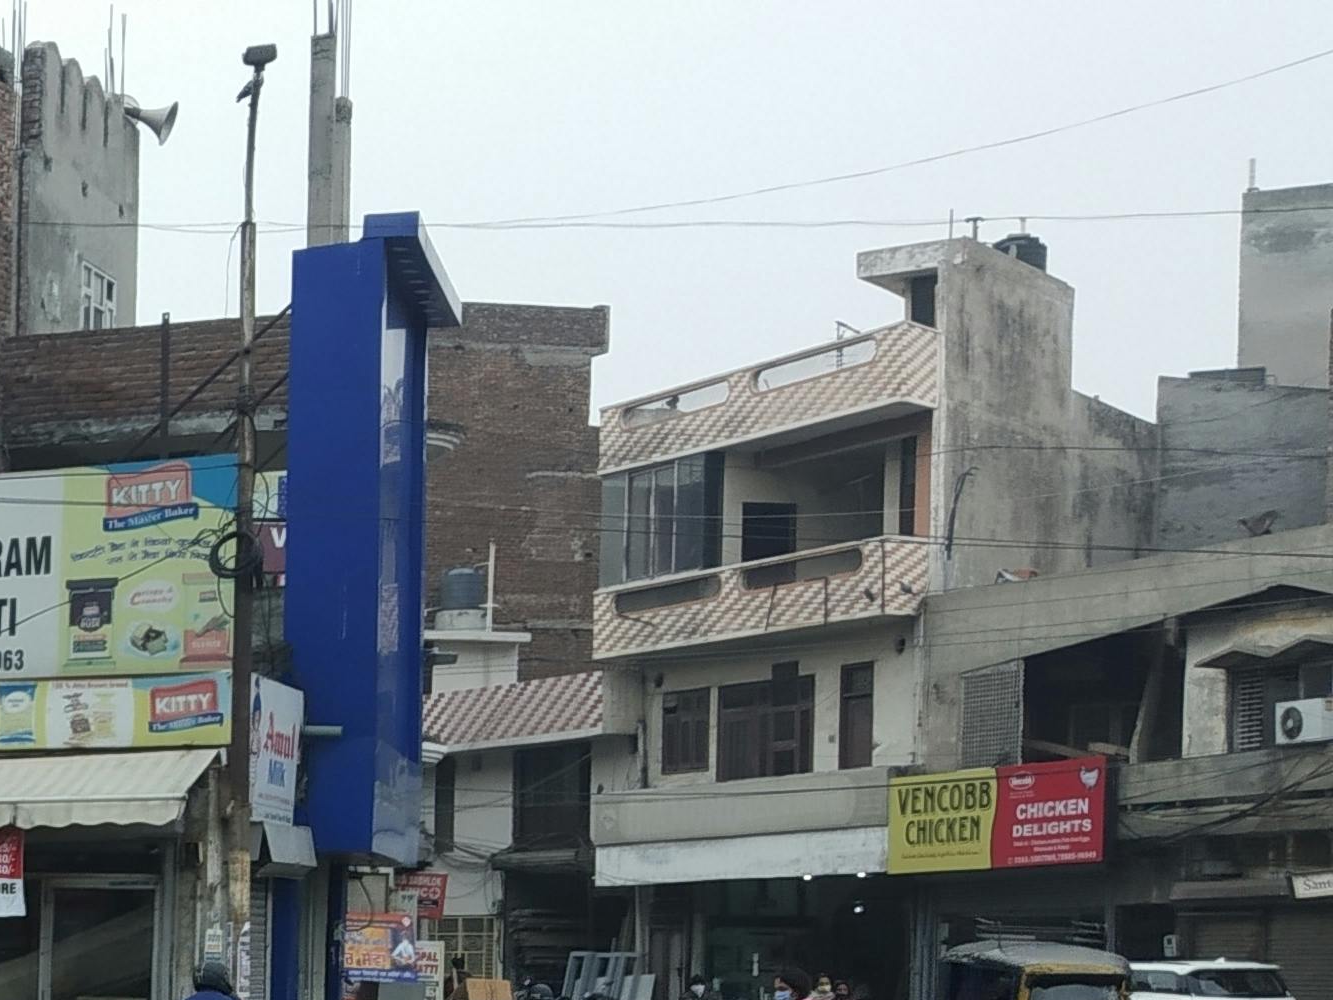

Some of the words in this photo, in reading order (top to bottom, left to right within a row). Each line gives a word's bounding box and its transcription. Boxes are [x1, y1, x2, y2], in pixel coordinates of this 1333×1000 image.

[112, 479, 182, 505] KITTY
[107, 521, 125, 530] The
[128, 512, 162, 527] Master
[165, 506, 194, 518] Baker
[155, 693, 213, 714] KITTY
[263, 711, 296, 760] Amul
[898, 781, 991, 817] VENCOBB
[1016, 797, 1089, 820] CHICKEN
[905, 815, 981, 848] CHICKEN
[1012, 818, 1092, 837] DELIGHTS
